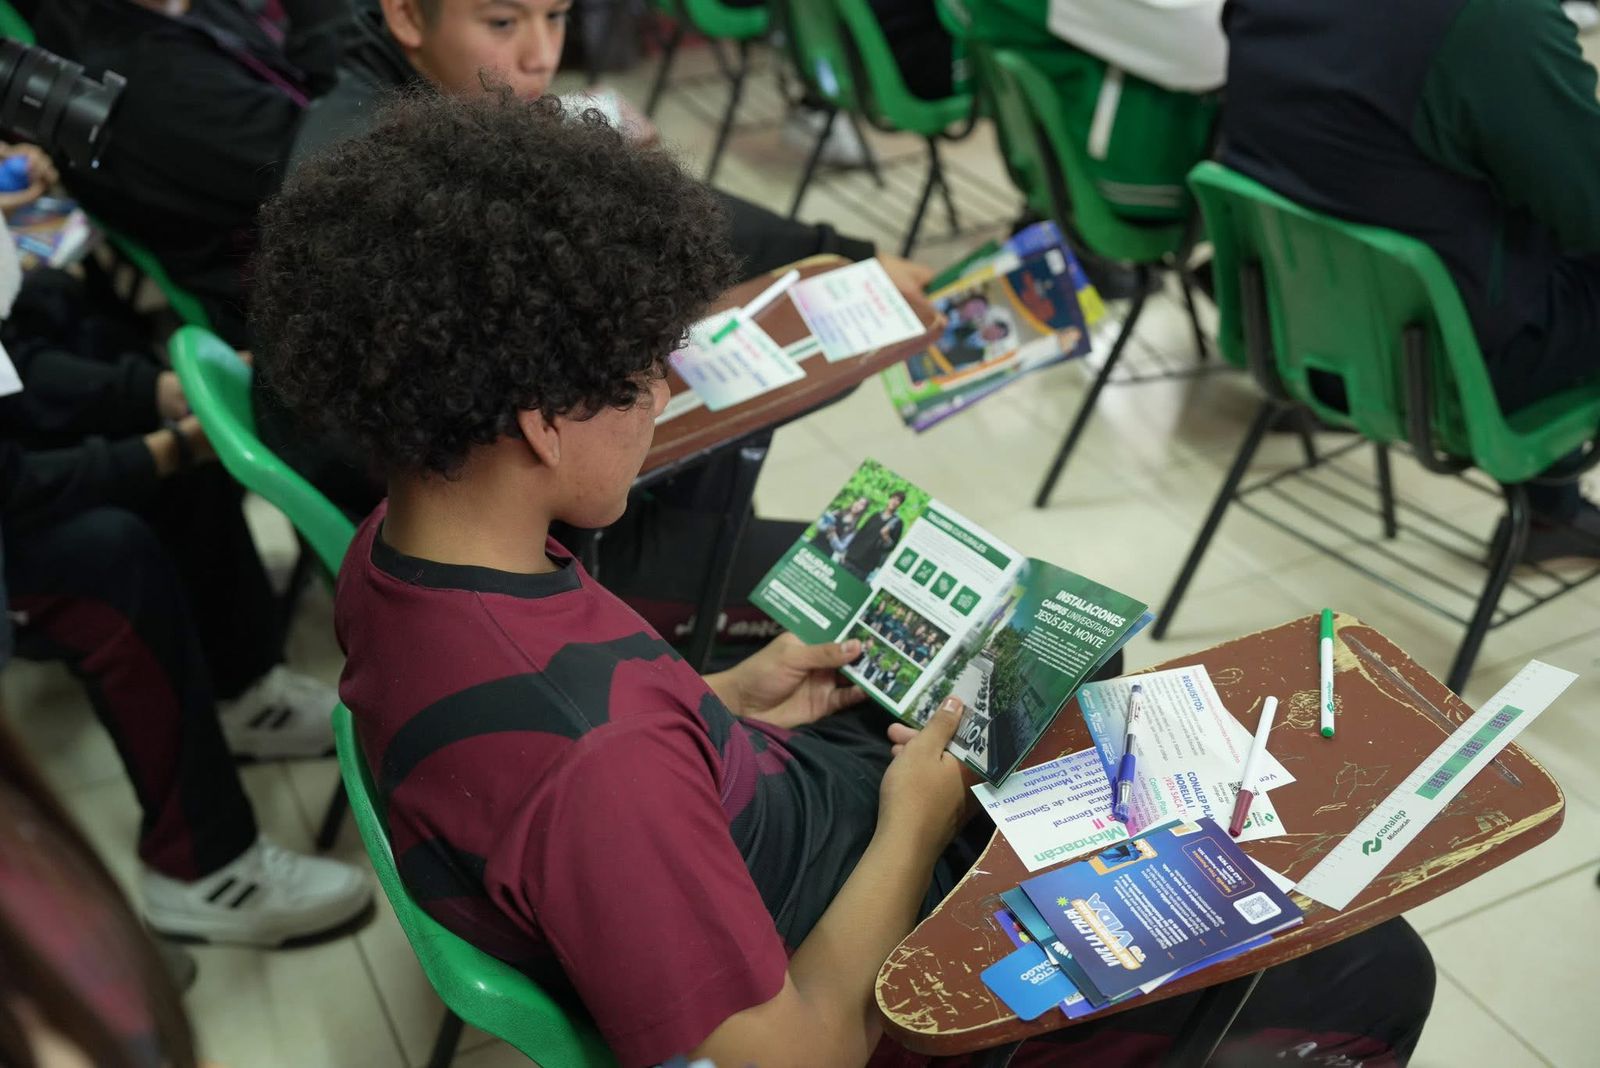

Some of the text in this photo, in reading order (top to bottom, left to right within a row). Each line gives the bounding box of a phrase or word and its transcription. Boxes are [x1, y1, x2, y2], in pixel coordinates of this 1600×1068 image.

[1041, 598, 1114, 637] CAMPUS UNIVERSITARIO
[1055, 589, 1126, 628] INSTALACIONES
[1033, 606, 1106, 648] JESÚS DEL MONTE
[1181, 674, 1205, 712] REQUISITOS:
[1022, 760, 1059, 775] Drones
[1060, 756, 1074, 764] de
[1068, 764, 1081, 772] de
[1084, 757, 1101, 766] ipo
[1002, 777, 1073, 803] Mantenimiento
[1068, 775, 1107, 790] rónicos
[1173, 773, 1193, 804] MORELIA
[1186, 771, 1206, 804] CONALEP
[987, 800, 1001, 809] de
[1004, 783, 1110, 822] enimiento de Sistemas
[1052, 809, 1093, 827] General
[1375, 808, 1406, 837] conalep
[1386, 817, 1411, 840] Michoacán
[1033, 826, 1126, 861] Michoacán
[1063, 907, 1093, 934] ETAPA
[1085, 892, 1134, 952] VIDA
[1084, 933, 1104, 947] LA
[1094, 944, 1120, 967] VIVE
[1019, 959, 1051, 981] DALGO
